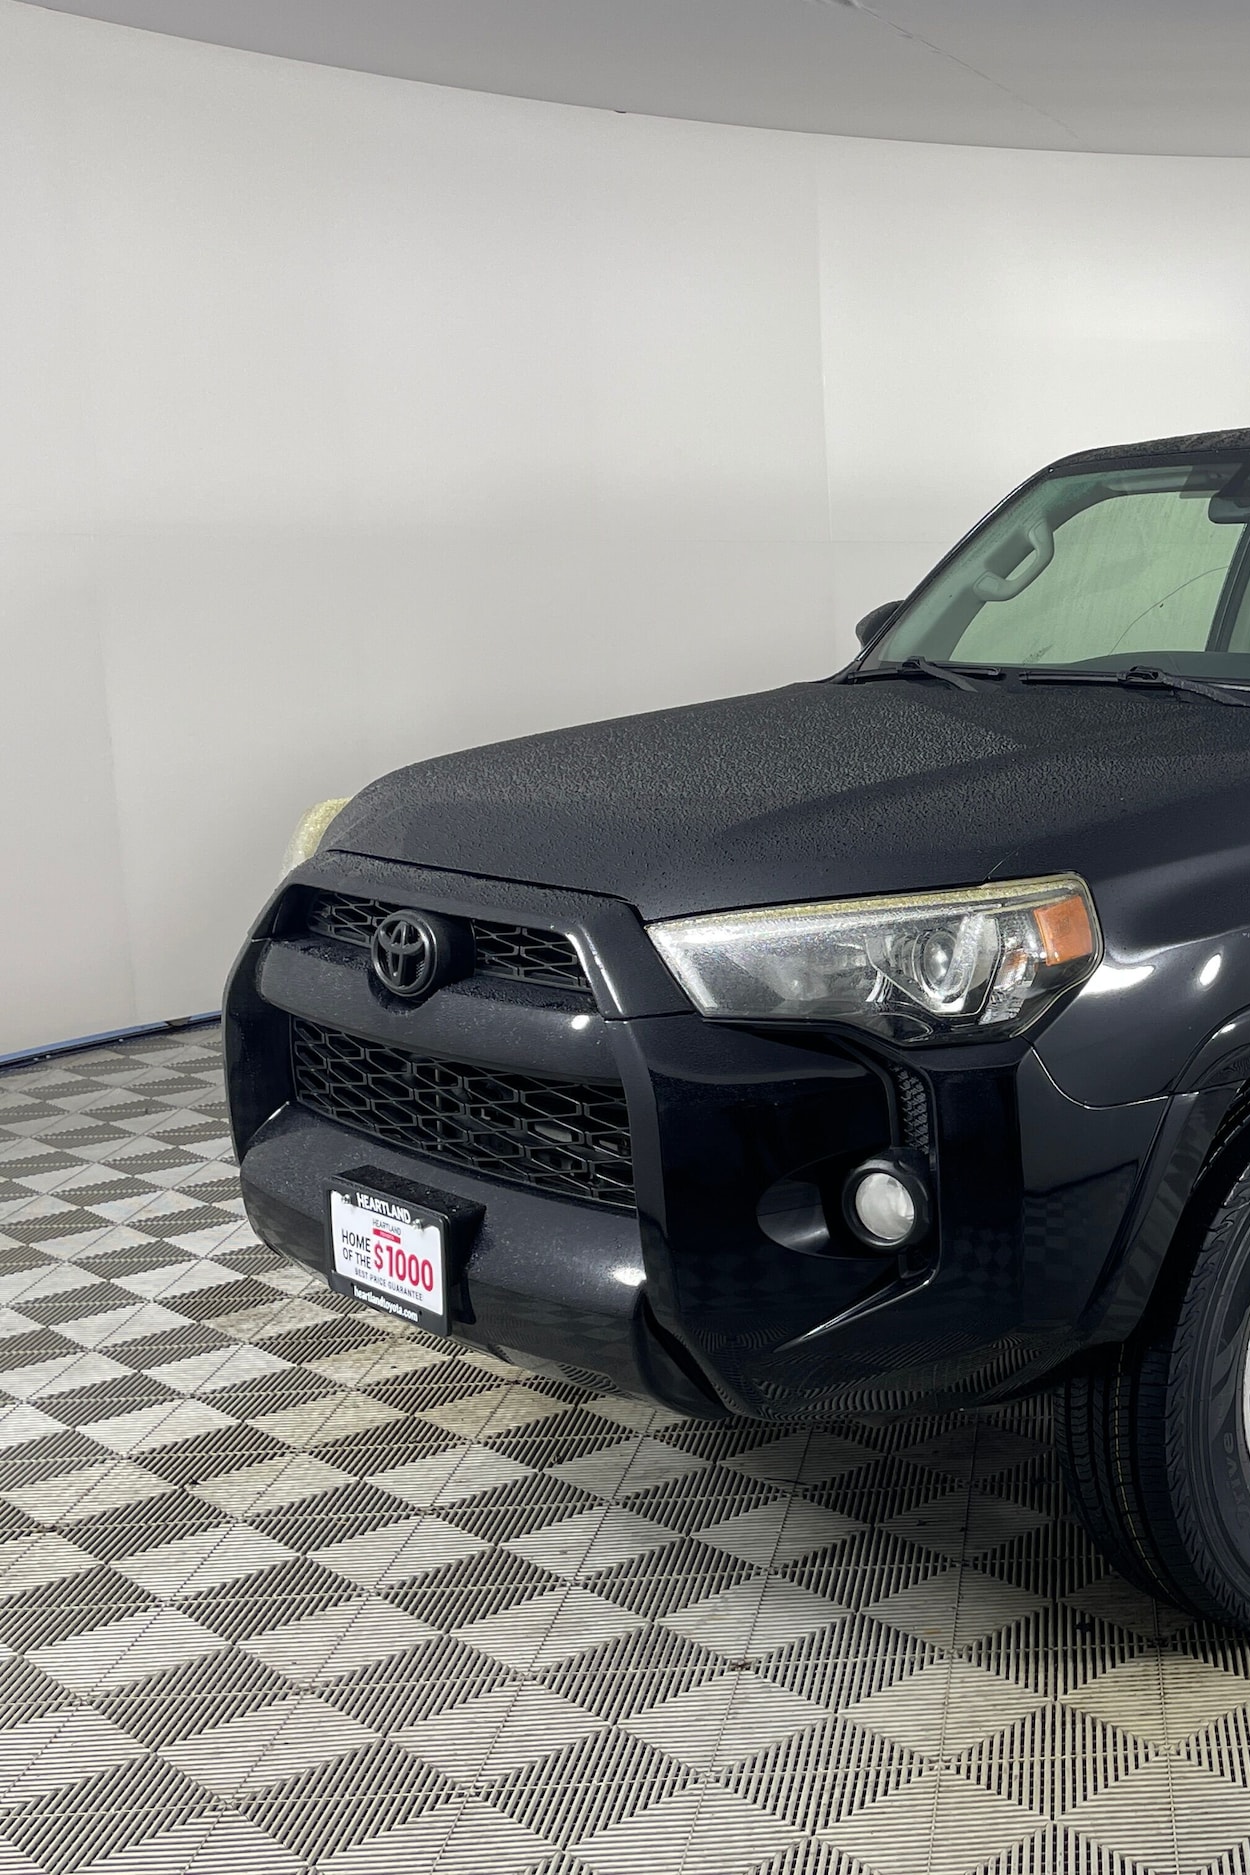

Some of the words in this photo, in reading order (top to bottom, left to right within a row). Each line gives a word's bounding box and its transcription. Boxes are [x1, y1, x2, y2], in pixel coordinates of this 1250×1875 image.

[356, 1192, 411, 1224] HEARTLAND
[342, 1229, 371, 1252] HOME
[372, 1218, 401, 1236] HEARTLAND
[343, 1247, 353, 1261] OF
[355, 1252, 371, 1270] THE
[374, 1240, 434, 1292] $1000
[355, 1267, 368, 1279] BEST
[370, 1273, 387, 1286] PRICE
[387, 1280, 423, 1301] GUARANTEE
[354, 1285, 419, 1322] heartlandtoyota.com
